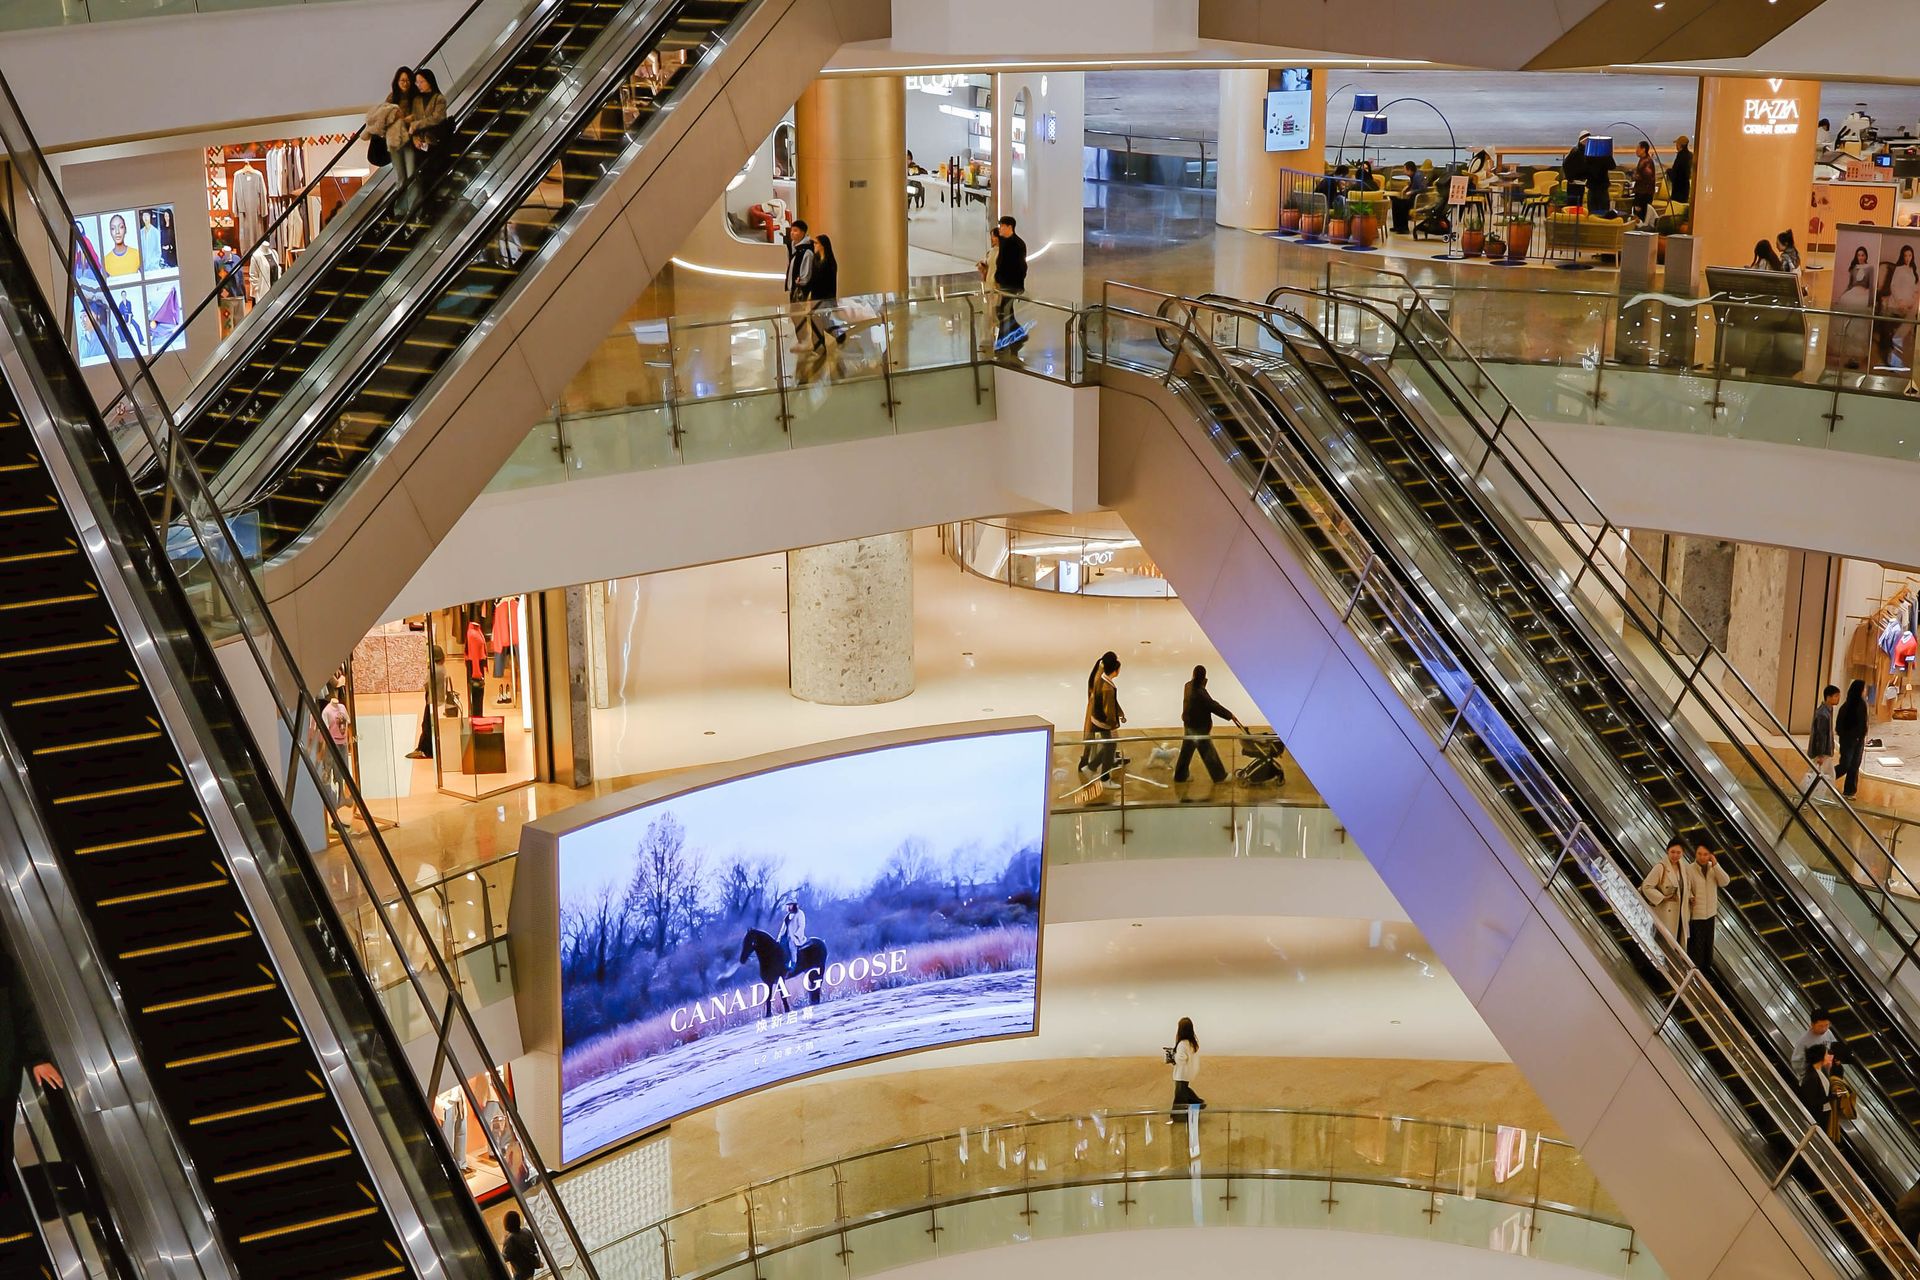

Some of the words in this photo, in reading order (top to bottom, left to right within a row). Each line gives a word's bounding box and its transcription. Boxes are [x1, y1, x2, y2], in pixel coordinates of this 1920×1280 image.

[1744, 99, 1799, 119] PIAZZA
[670, 976, 790, 1032] CANADA
[803, 949, 908, 992] GOOSE
[755, 1006, 814, 1033] 焕新启幕
